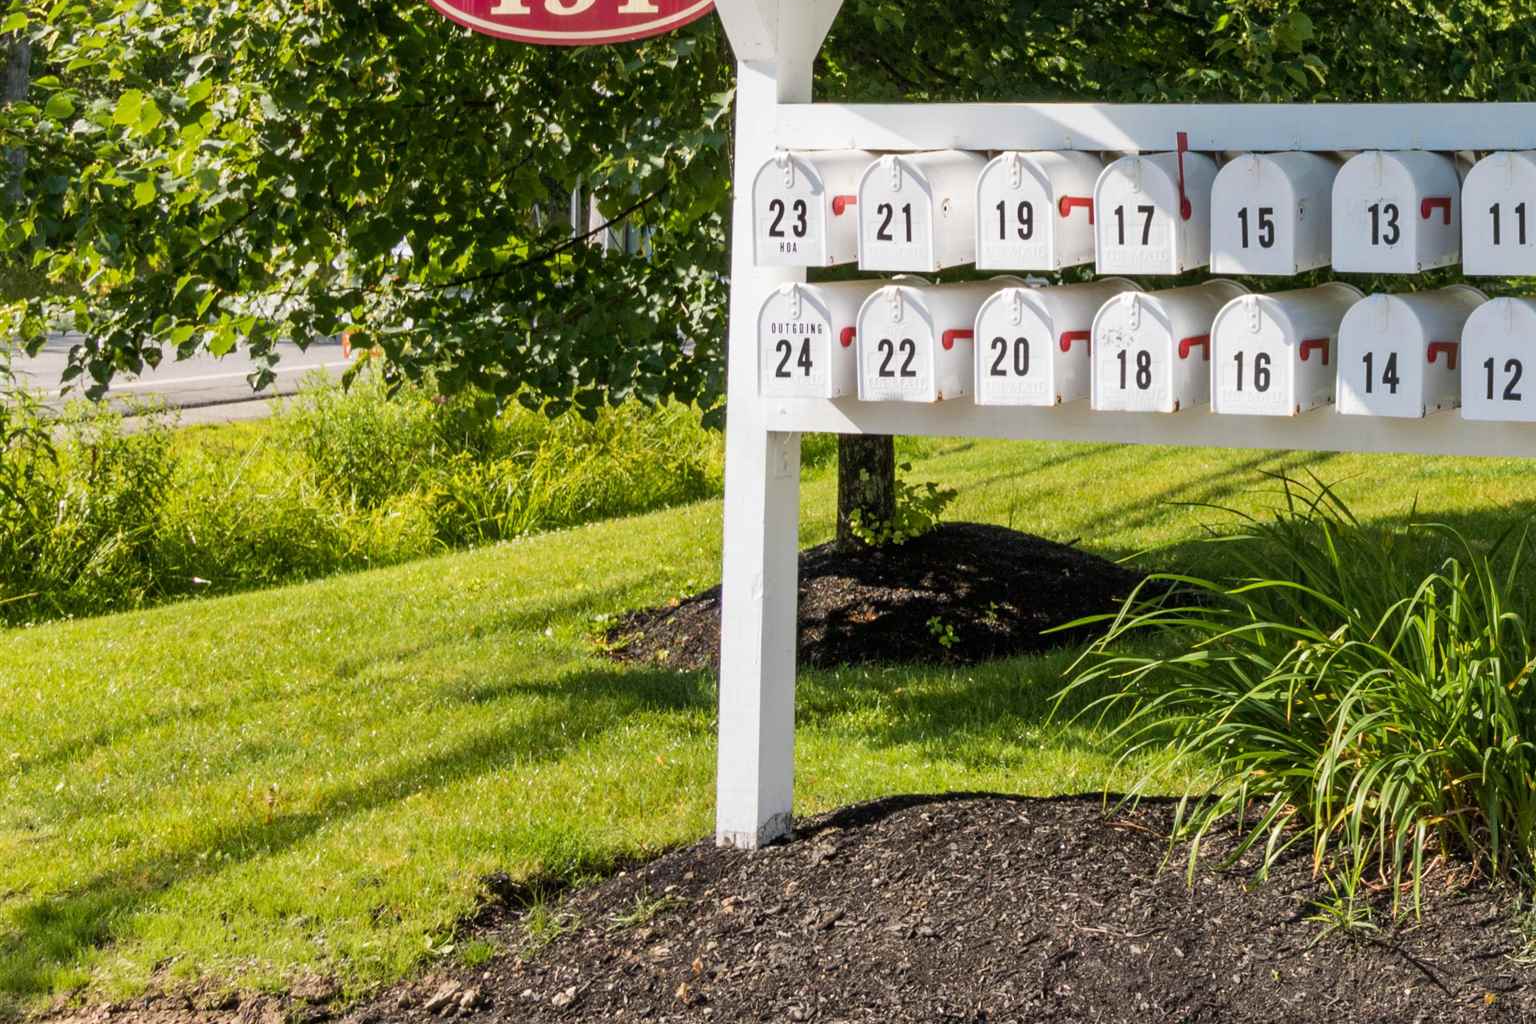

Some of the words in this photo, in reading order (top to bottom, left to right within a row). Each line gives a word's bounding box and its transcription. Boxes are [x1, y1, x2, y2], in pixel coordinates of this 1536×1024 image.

[769, 198, 807, 238] 23
[876, 203, 912, 242] 21
[996, 200, 1033, 241] 19
[1114, 205, 1155, 246] 17
[1237, 207, 1275, 249] 15
[1367, 203, 1401, 246] 13
[1489, 202, 1527, 246] 11
[779, 241, 798, 253] HOA
[771, 322, 823, 334] OUTGOING
[775, 337, 813, 378] 24
[878, 338, 917, 378] 22
[990, 336, 1030, 377] 20
[1117, 349, 1152, 390] 18
[1234, 351, 1271, 393] 16
[1362, 351, 1400, 395] 14
[1483, 357, 1523, 402] 12
